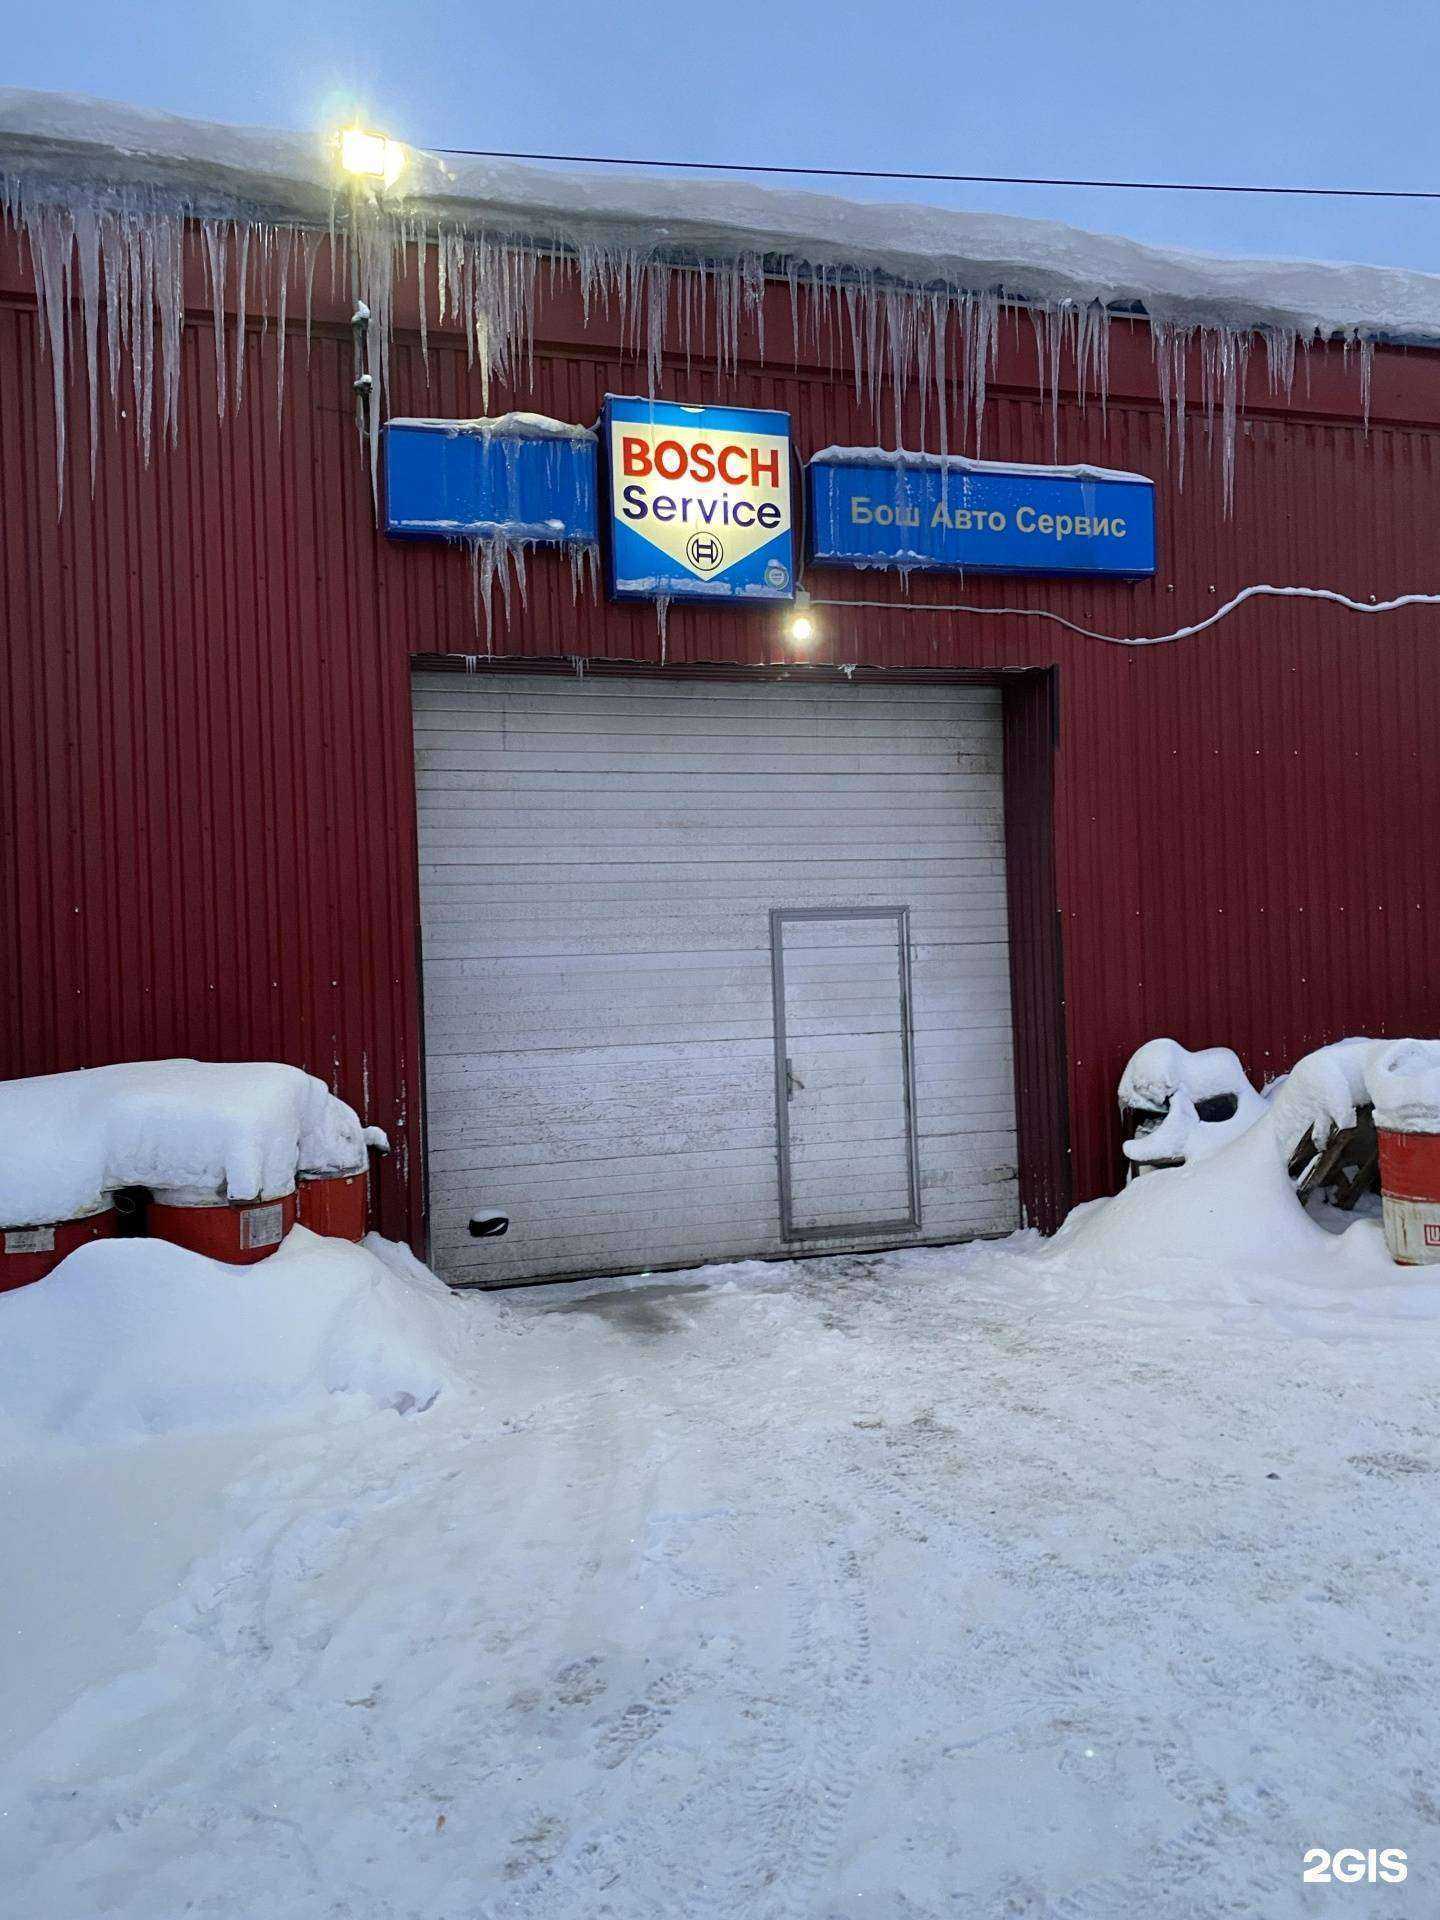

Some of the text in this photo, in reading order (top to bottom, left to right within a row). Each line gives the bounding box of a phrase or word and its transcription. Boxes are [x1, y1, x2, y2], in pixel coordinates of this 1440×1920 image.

[622, 436, 780, 488] BOSCH
[622, 484, 782, 529] Service
[851, 496, 1127, 540] Бош Авто Сервис
